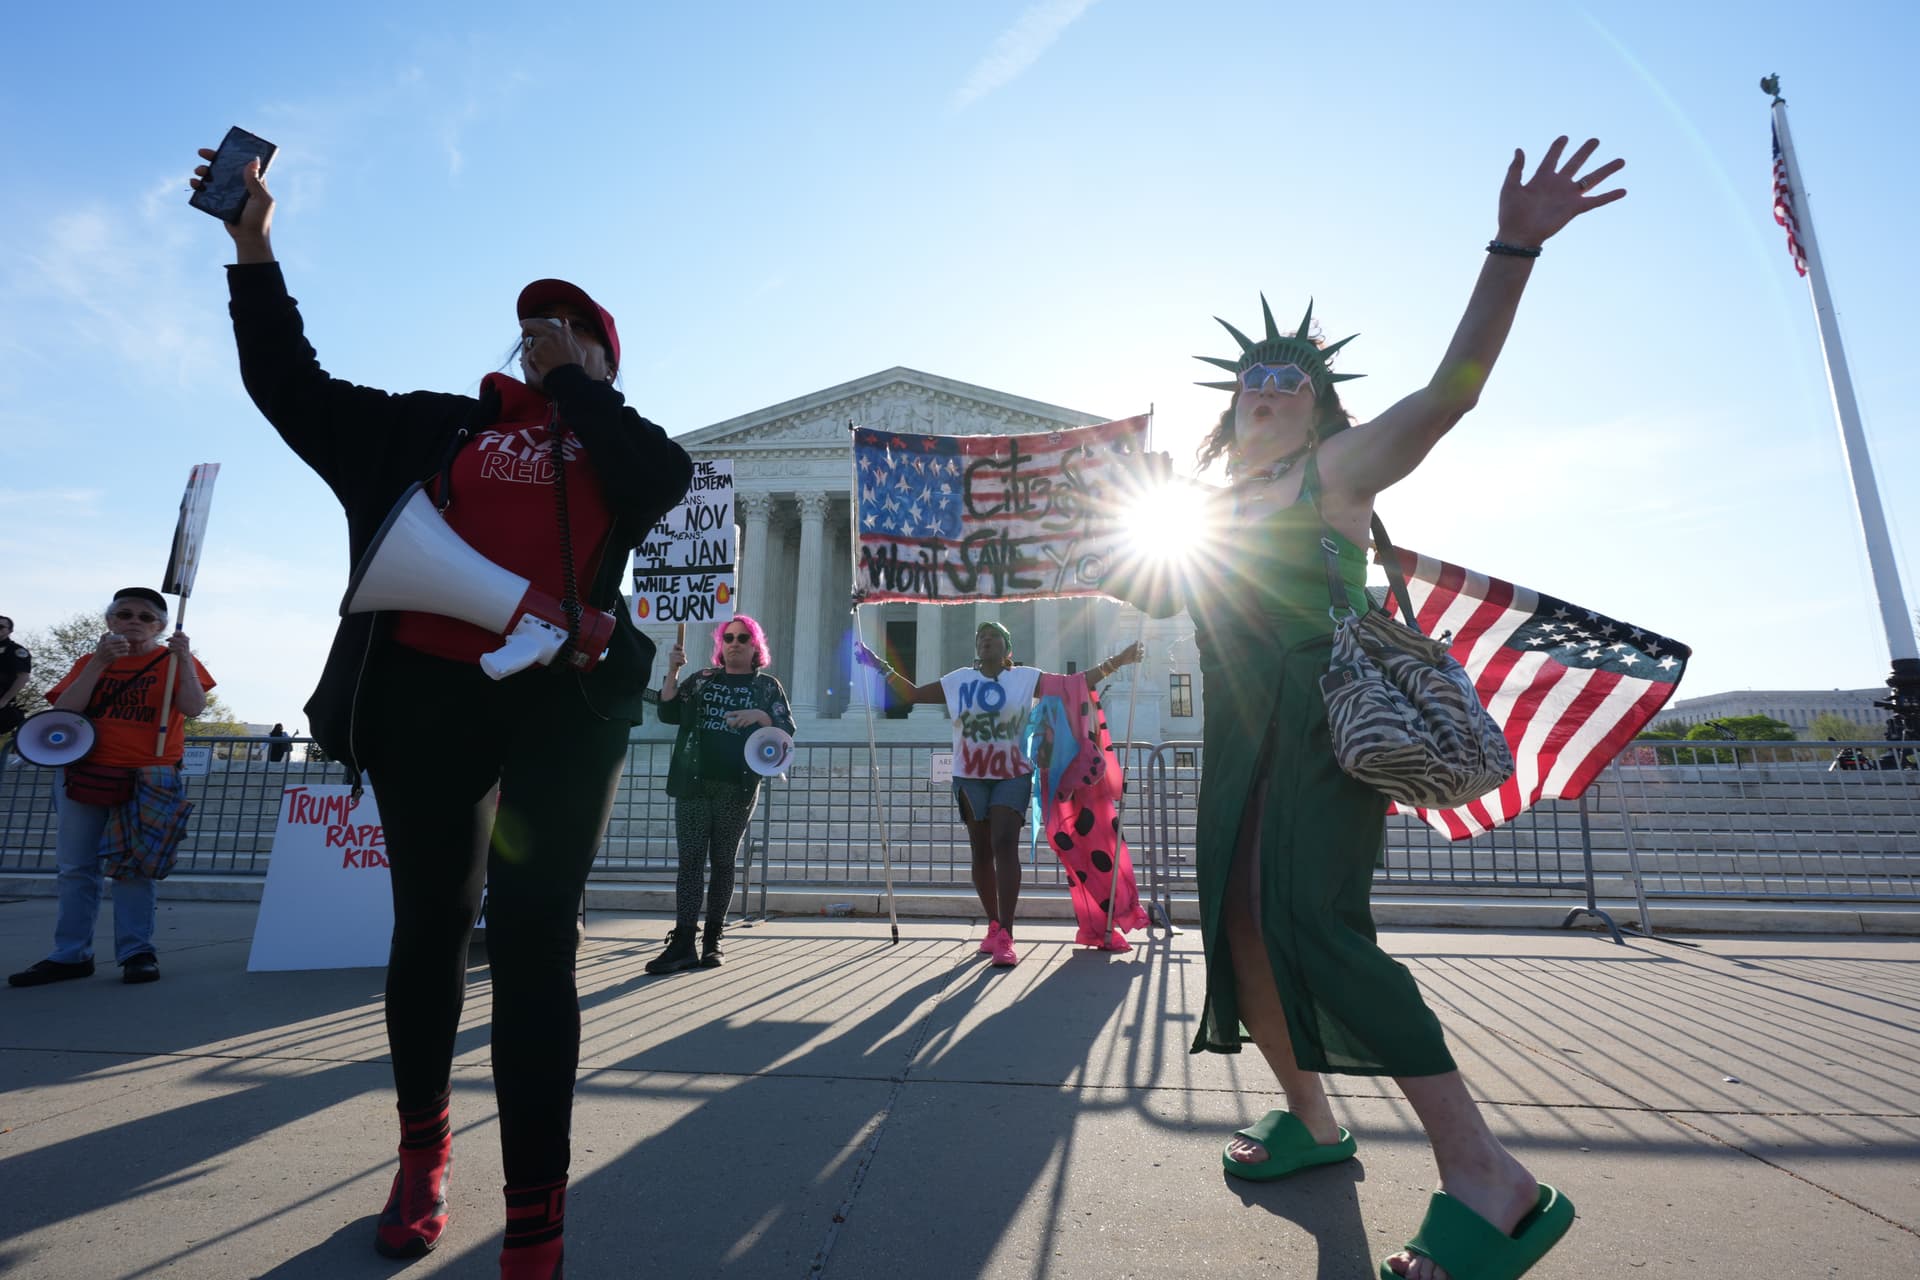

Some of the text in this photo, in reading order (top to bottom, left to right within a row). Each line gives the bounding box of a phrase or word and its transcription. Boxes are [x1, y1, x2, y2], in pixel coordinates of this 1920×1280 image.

[481, 451, 560, 485] RED
[692, 461, 717, 475] THE
[689, 474, 733, 493] IDTERM
[680, 496, 705, 505] ANS:
[685, 503, 728, 531] NOV
[671, 531, 704, 541] MEANS:
[635, 541, 673, 557] WAIT
[685, 539, 727, 566] JAN
[647, 557, 672, 568] TIL
[634, 575, 717, 594] WHILE WE
[656, 594, 715, 622] BURN
[958, 679, 1007, 713] NO
[283, 786, 360, 827] TRUMP
